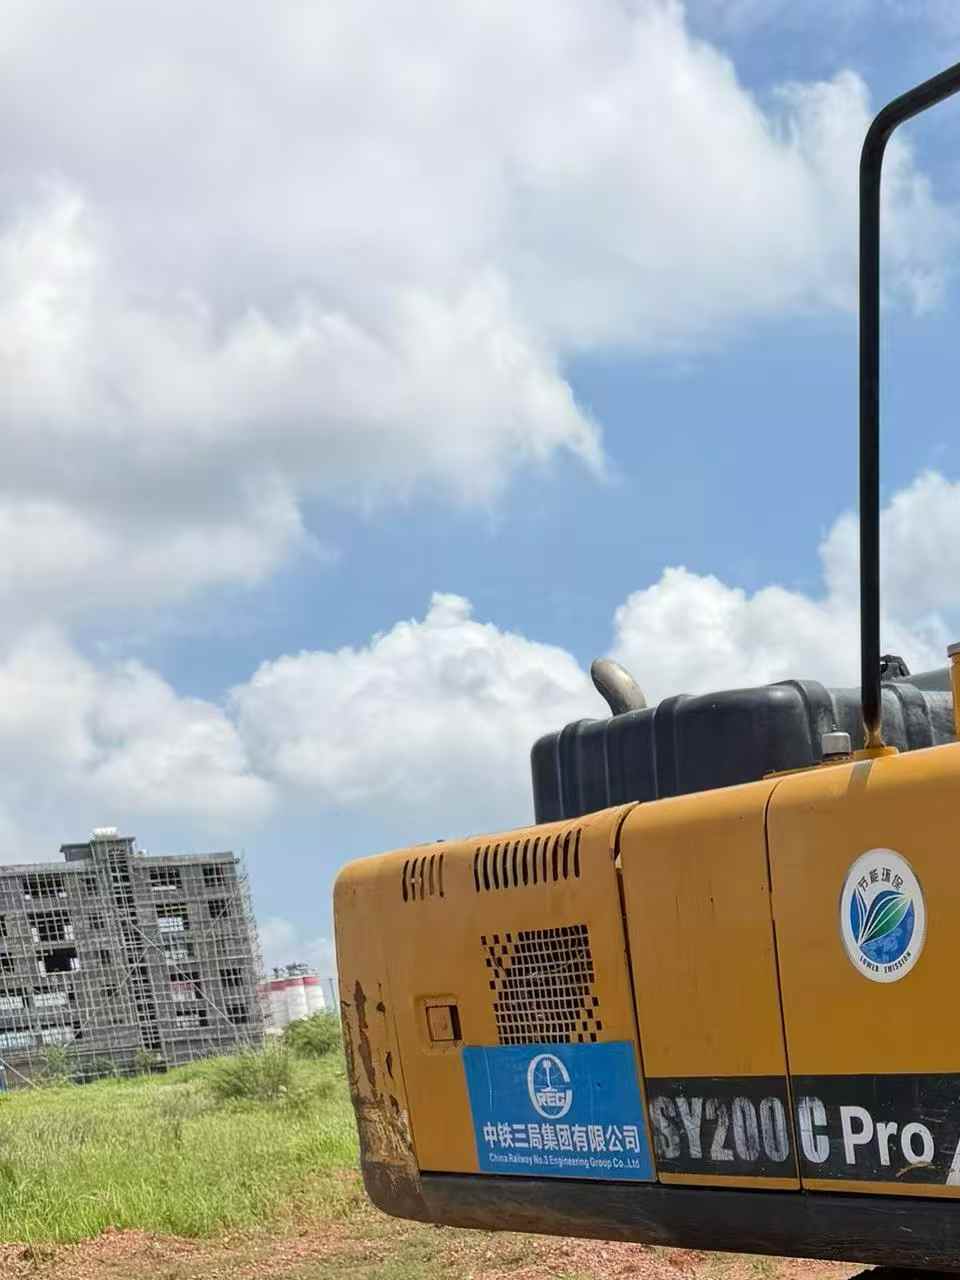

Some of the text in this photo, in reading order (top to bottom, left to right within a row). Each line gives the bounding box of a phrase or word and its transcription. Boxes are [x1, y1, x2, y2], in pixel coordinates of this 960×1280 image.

[483, 1122, 641, 1153] 中铁三局集团有限公司
[840, 1105, 935, 1166] Pro
[489, 1153, 508, 1163] China
[508, 1154, 533, 1166] Railway
[549, 1155, 590, 1168] Engineering
[590, 1157, 612, 1170] Group
